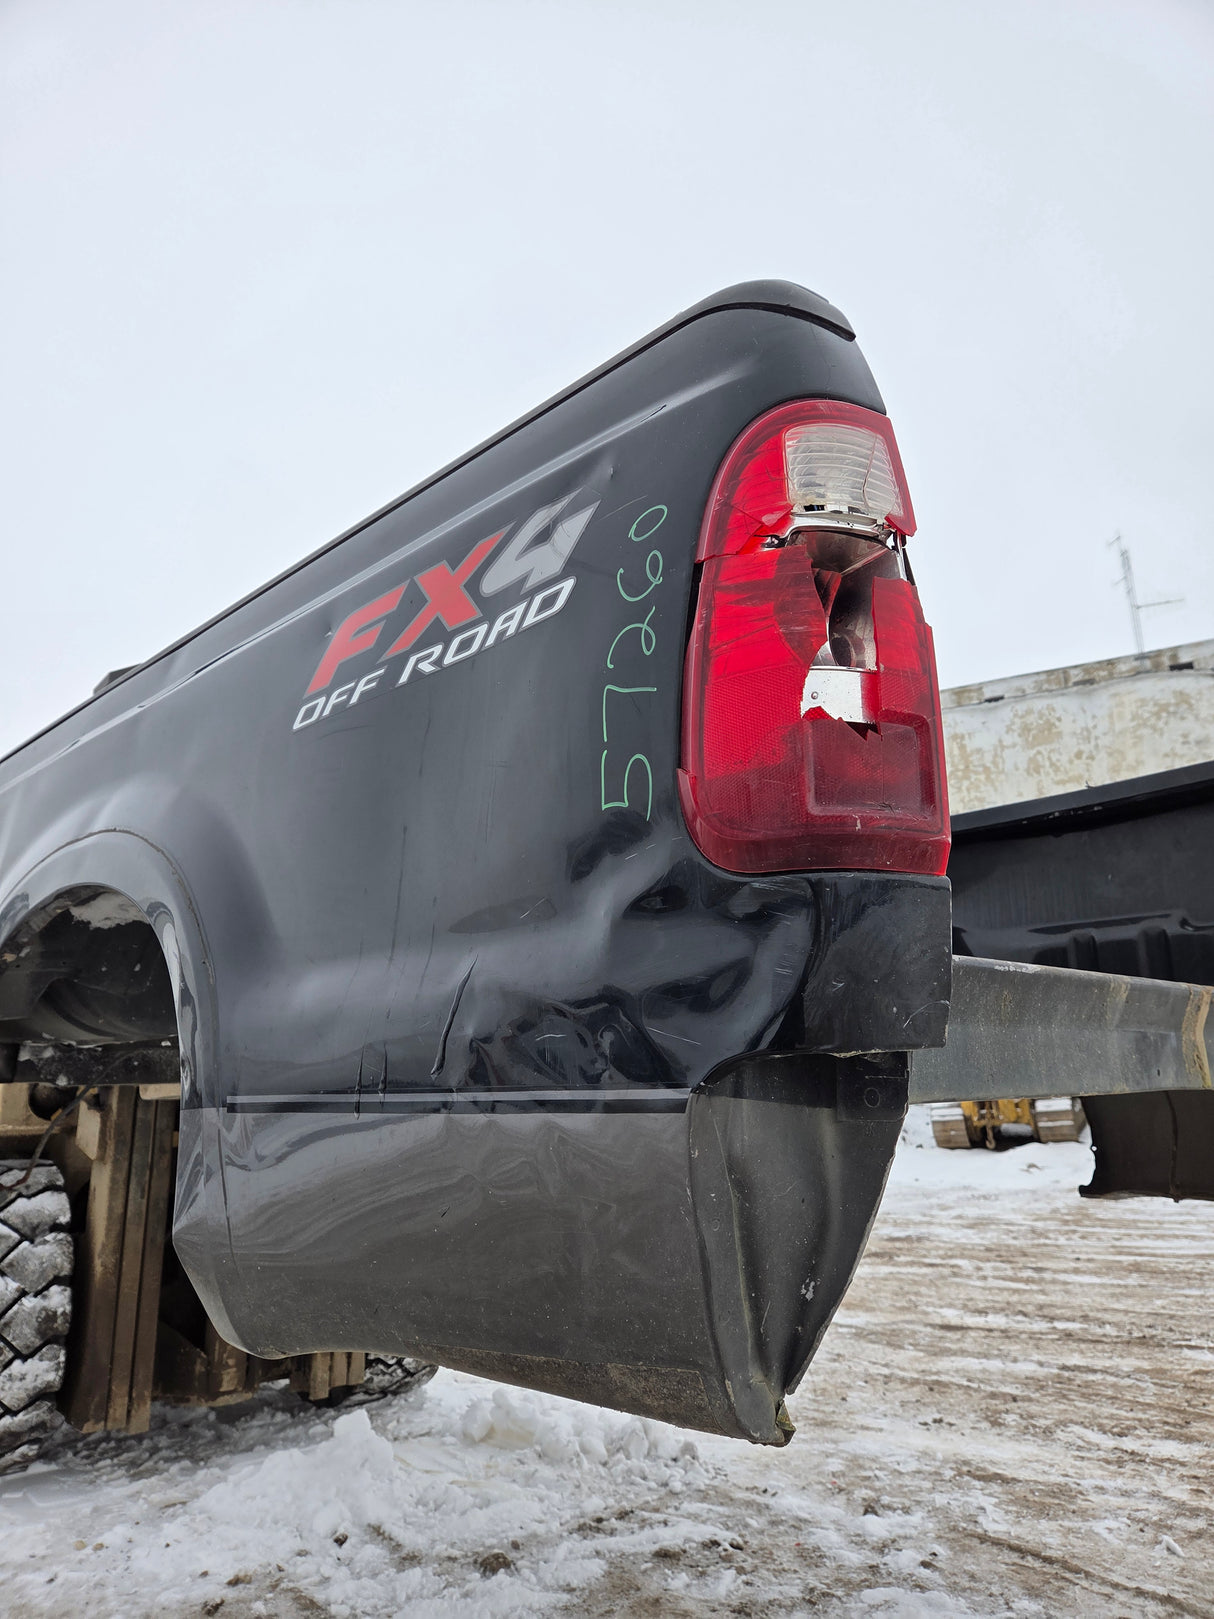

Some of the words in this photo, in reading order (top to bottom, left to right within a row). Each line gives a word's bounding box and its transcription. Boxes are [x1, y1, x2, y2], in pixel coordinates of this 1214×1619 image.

[292, 667, 386, 730] OFF
[398, 576, 577, 685] ROAD
[305, 487, 600, 697] FX4
[601, 504, 668, 822] 57260
